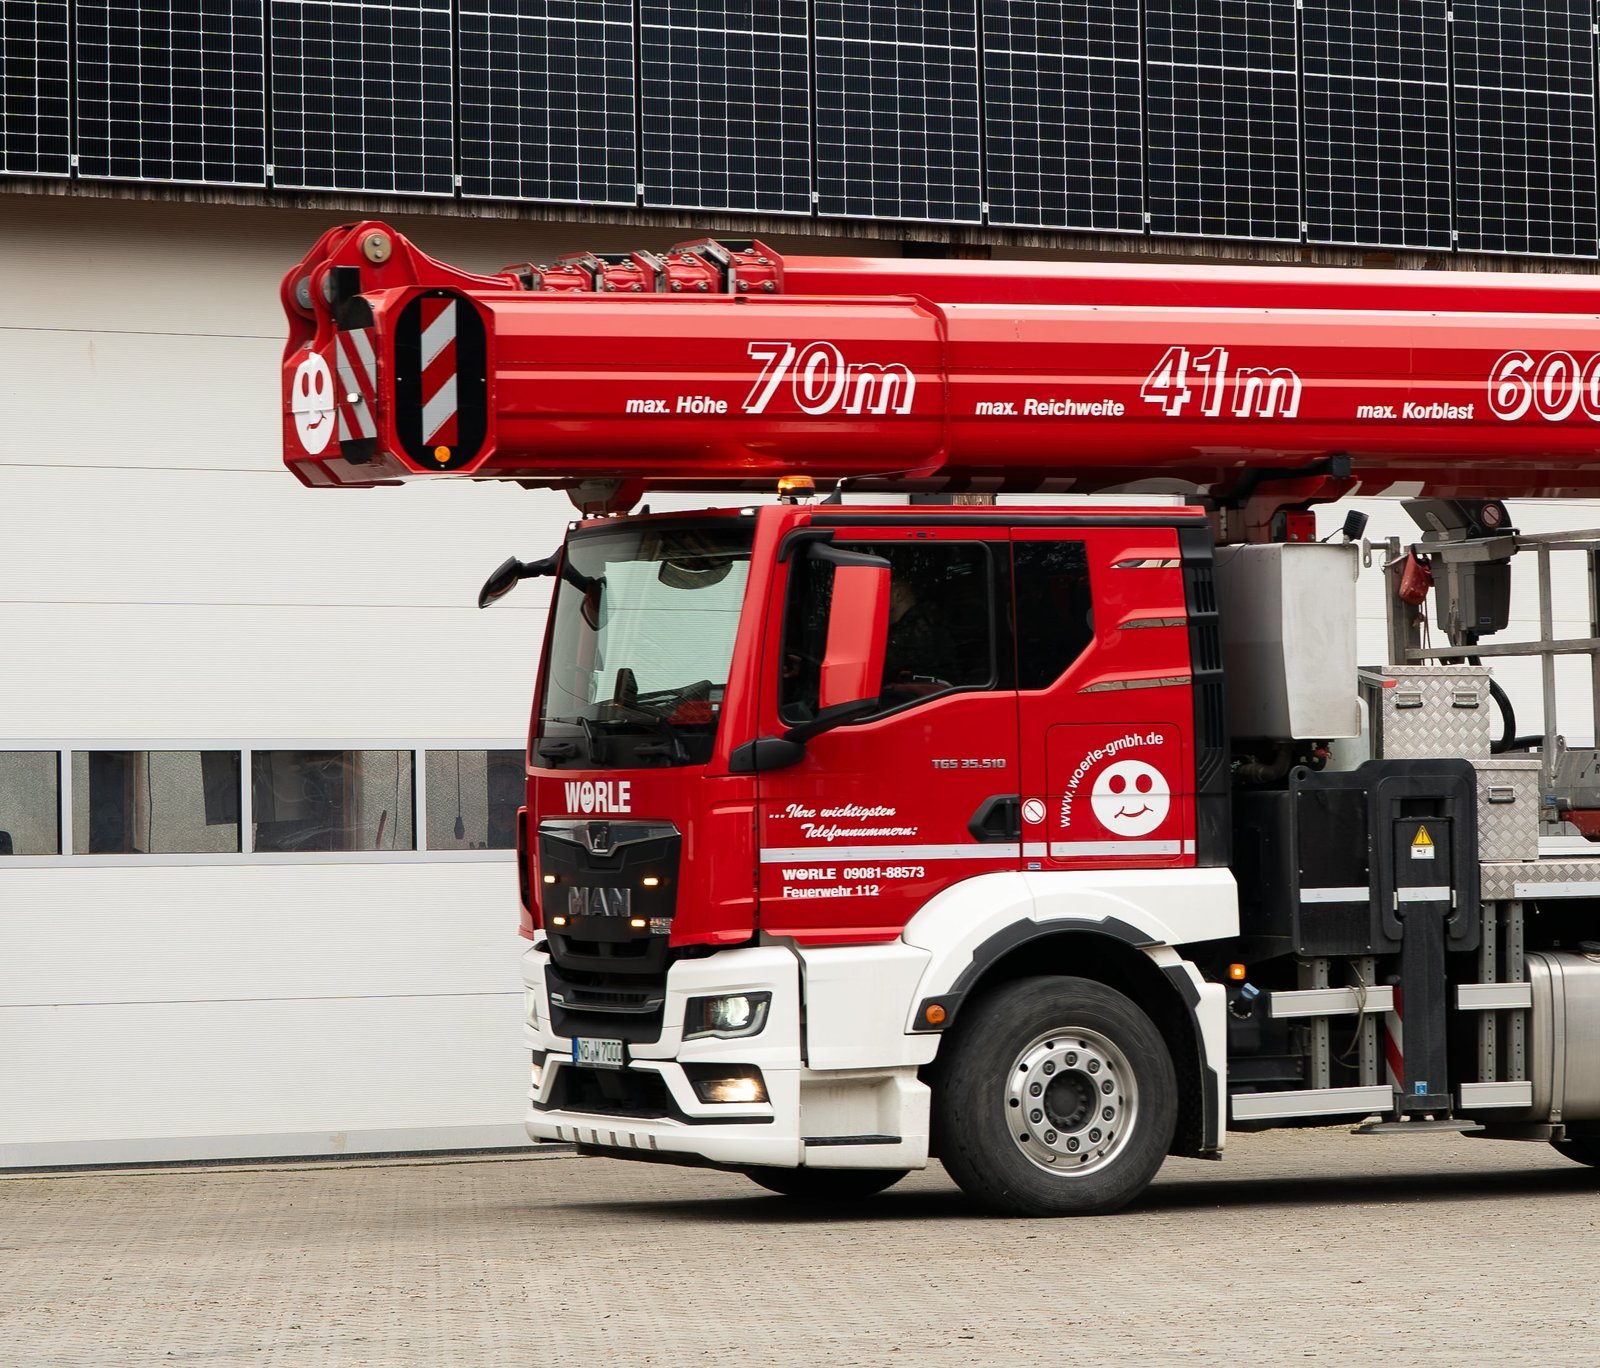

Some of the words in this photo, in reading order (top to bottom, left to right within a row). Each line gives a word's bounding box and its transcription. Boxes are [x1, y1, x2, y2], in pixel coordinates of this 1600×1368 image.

[625, 399, 670, 413] max.
[676, 395, 728, 414] Höhe
[741, 341, 916, 415] 70m
[975, 401, 1018, 416] max.
[1023, 398, 1125, 417] Reichweite
[1140, 346, 1303, 418] 41m
[1356, 405, 1398, 419] max.
[1402, 402, 1475, 420] Korblast
[932, 759, 958, 769] TGS
[960, 758, 1006, 769] 35.510
[1060, 731, 1164, 828] www.woerle-gmbh.de
[820, 803, 896, 822] wichtigsten
[800, 823, 918, 842] Telefonnummern:
[843, 866, 925, 880] 09081-88573
[783, 885, 852, 898] Feuerwehr
[855, 884, 880, 897] 112
[568, 886, 632, 917] MAN
